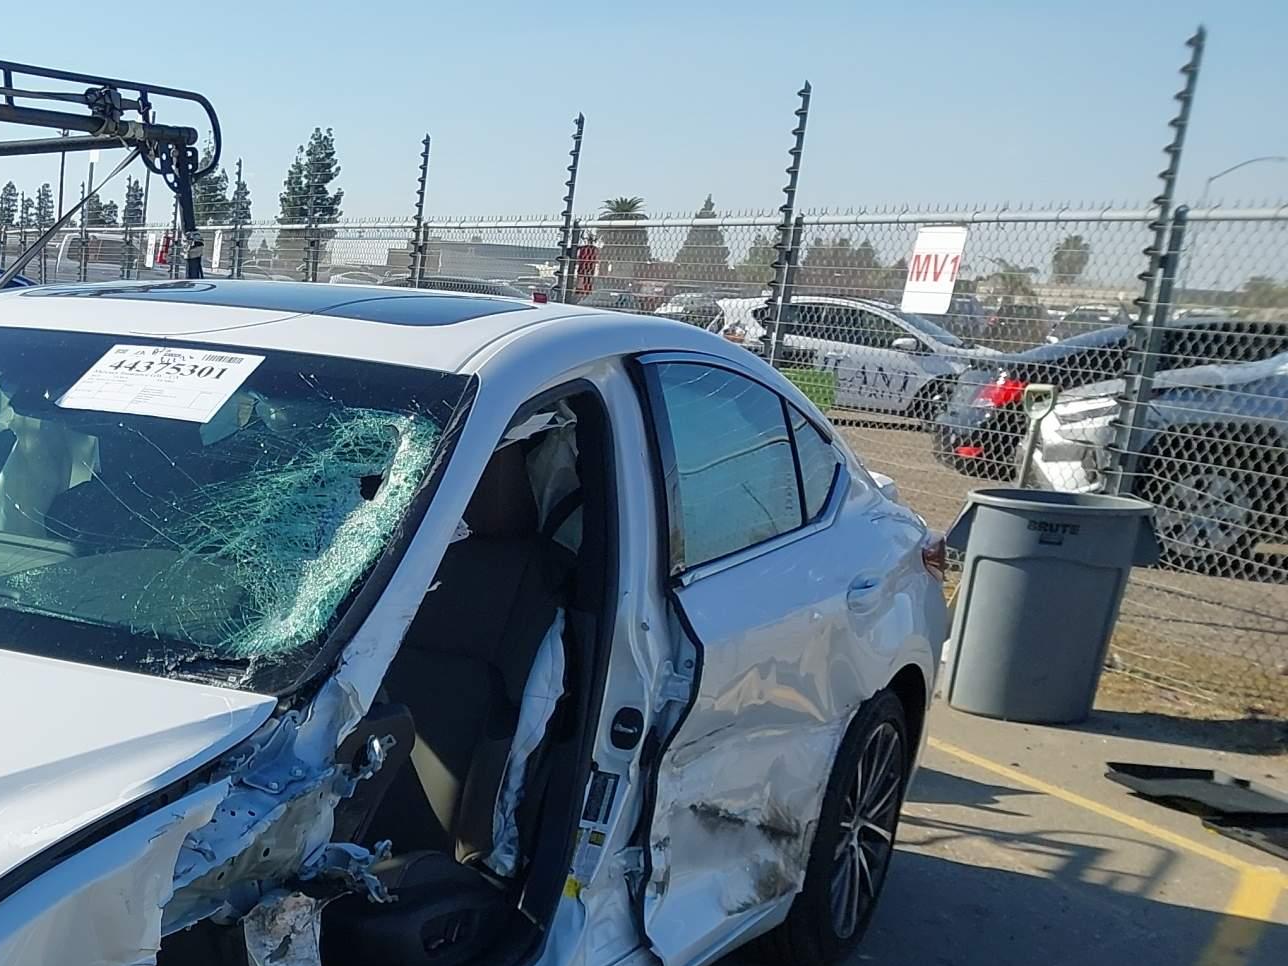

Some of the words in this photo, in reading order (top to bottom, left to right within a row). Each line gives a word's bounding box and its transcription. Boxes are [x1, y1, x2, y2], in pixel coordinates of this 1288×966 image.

[909, 254, 961, 282] MV1
[109, 359, 229, 380] 44375301
[1027, 520, 1081, 535] BRUTE
